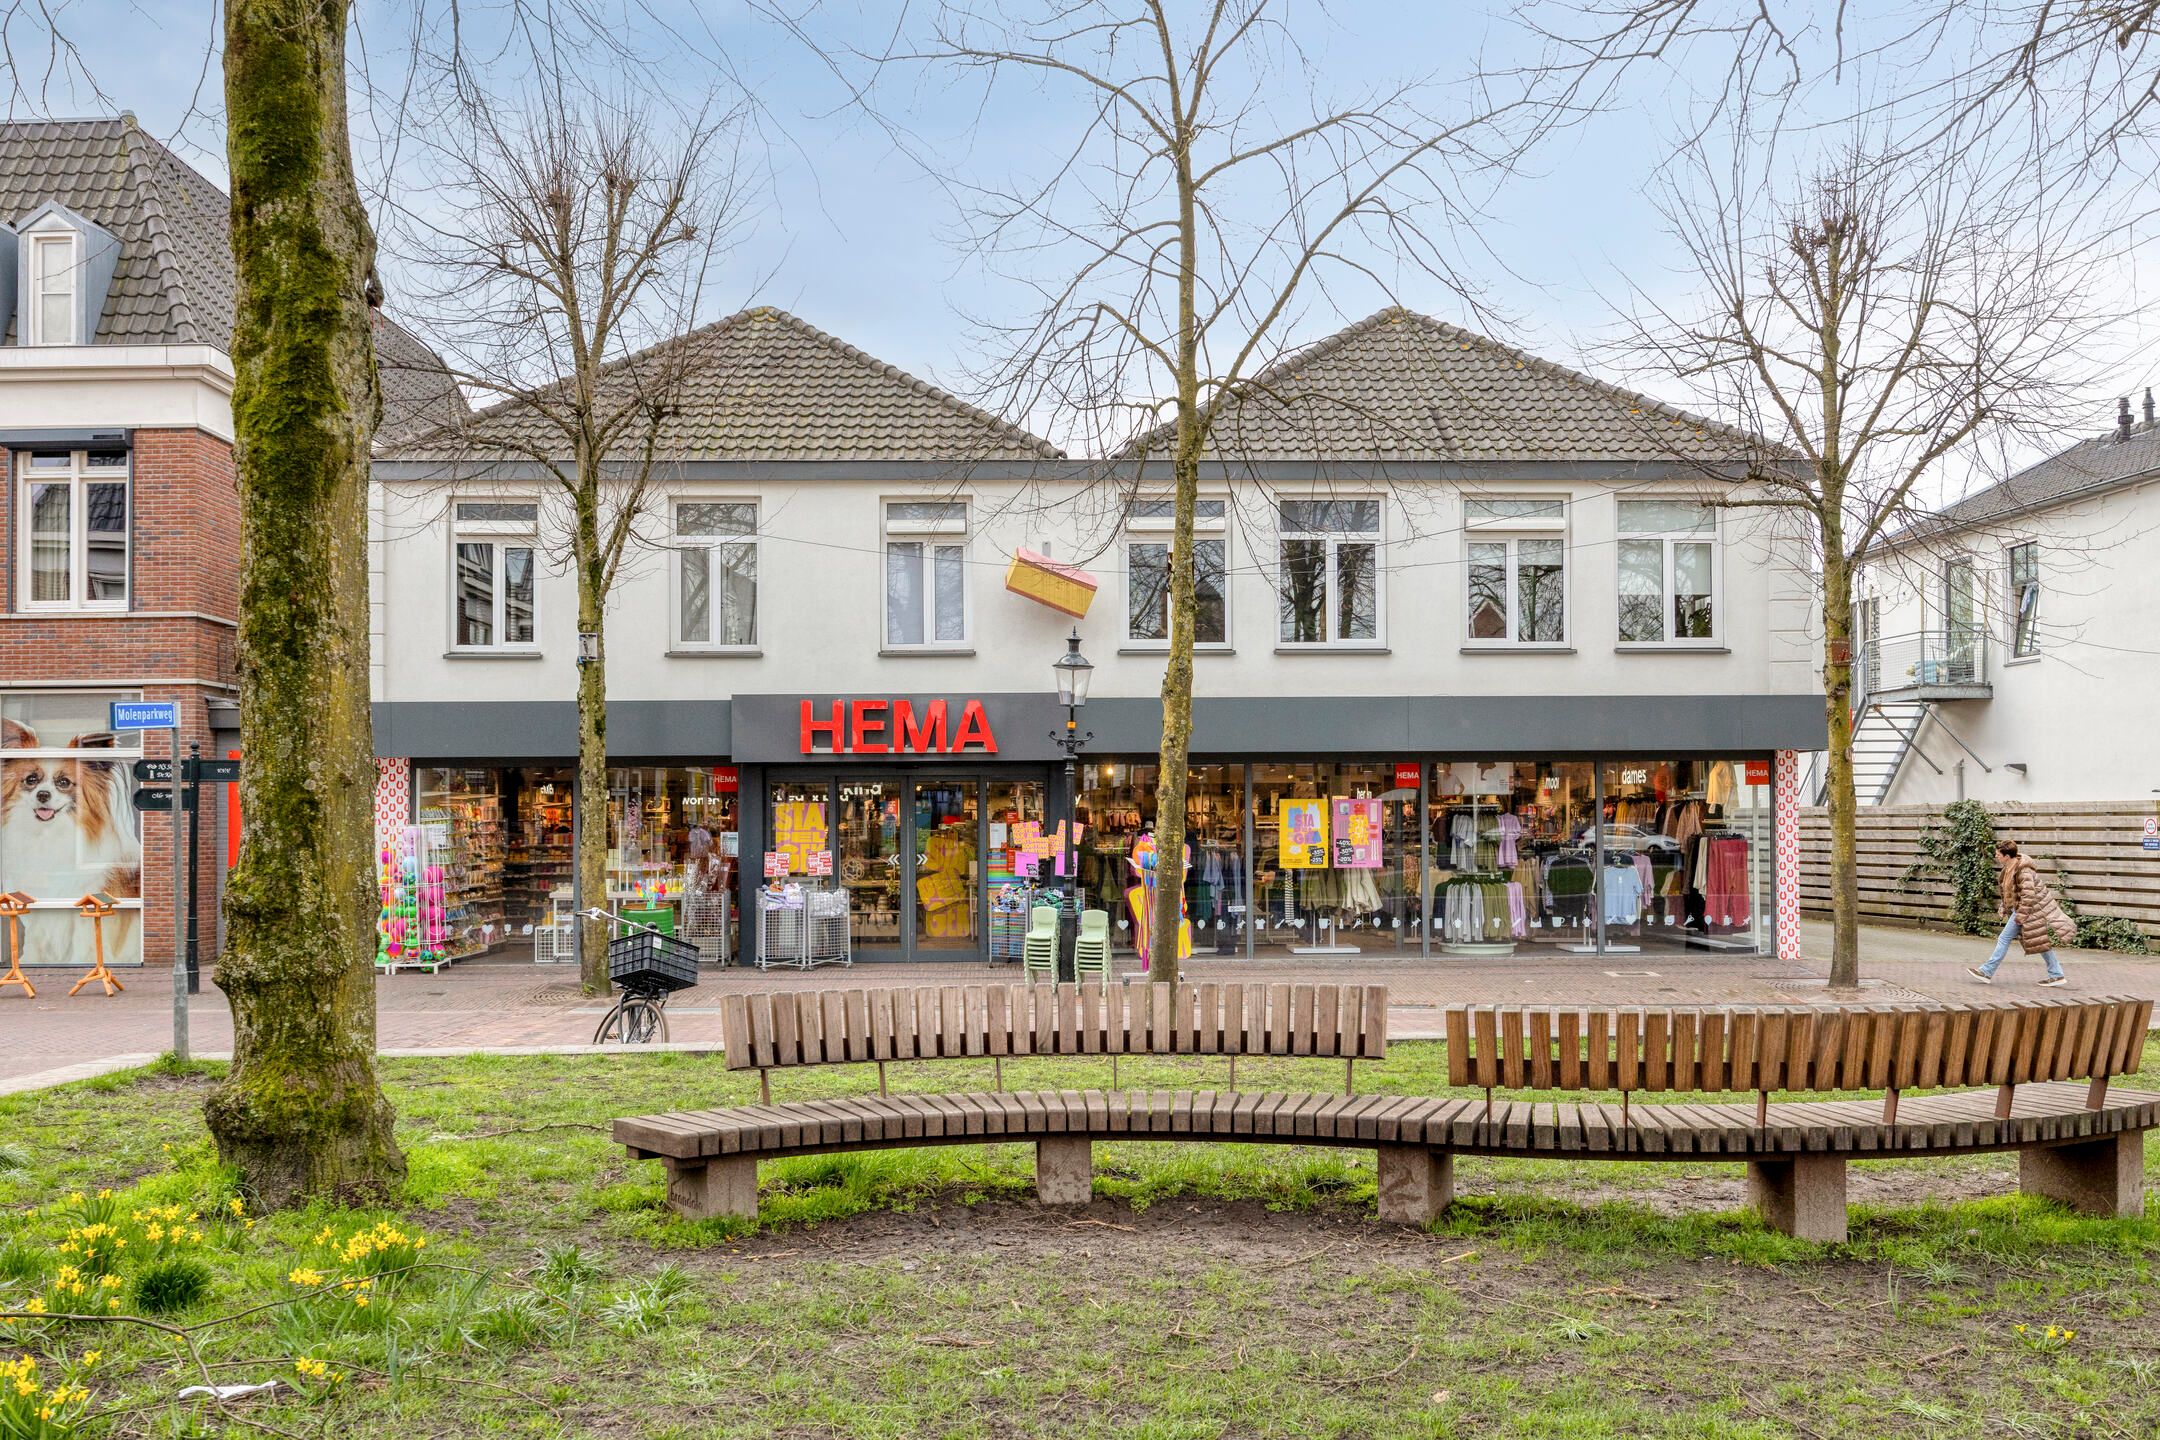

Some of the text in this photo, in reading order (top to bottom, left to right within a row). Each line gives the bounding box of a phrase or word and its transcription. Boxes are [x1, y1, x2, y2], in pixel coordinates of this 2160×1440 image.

[117, 708, 173, 723] Molenparkweg
[801, 699, 998, 753] HEMA
[714, 775, 737, 783] HEMA
[1396, 771, 1420, 779] HEMA
[1621, 768, 1647, 785] dames
[1746, 769, 1769, 777] HEMA
[776, 801, 825, 831] STA
